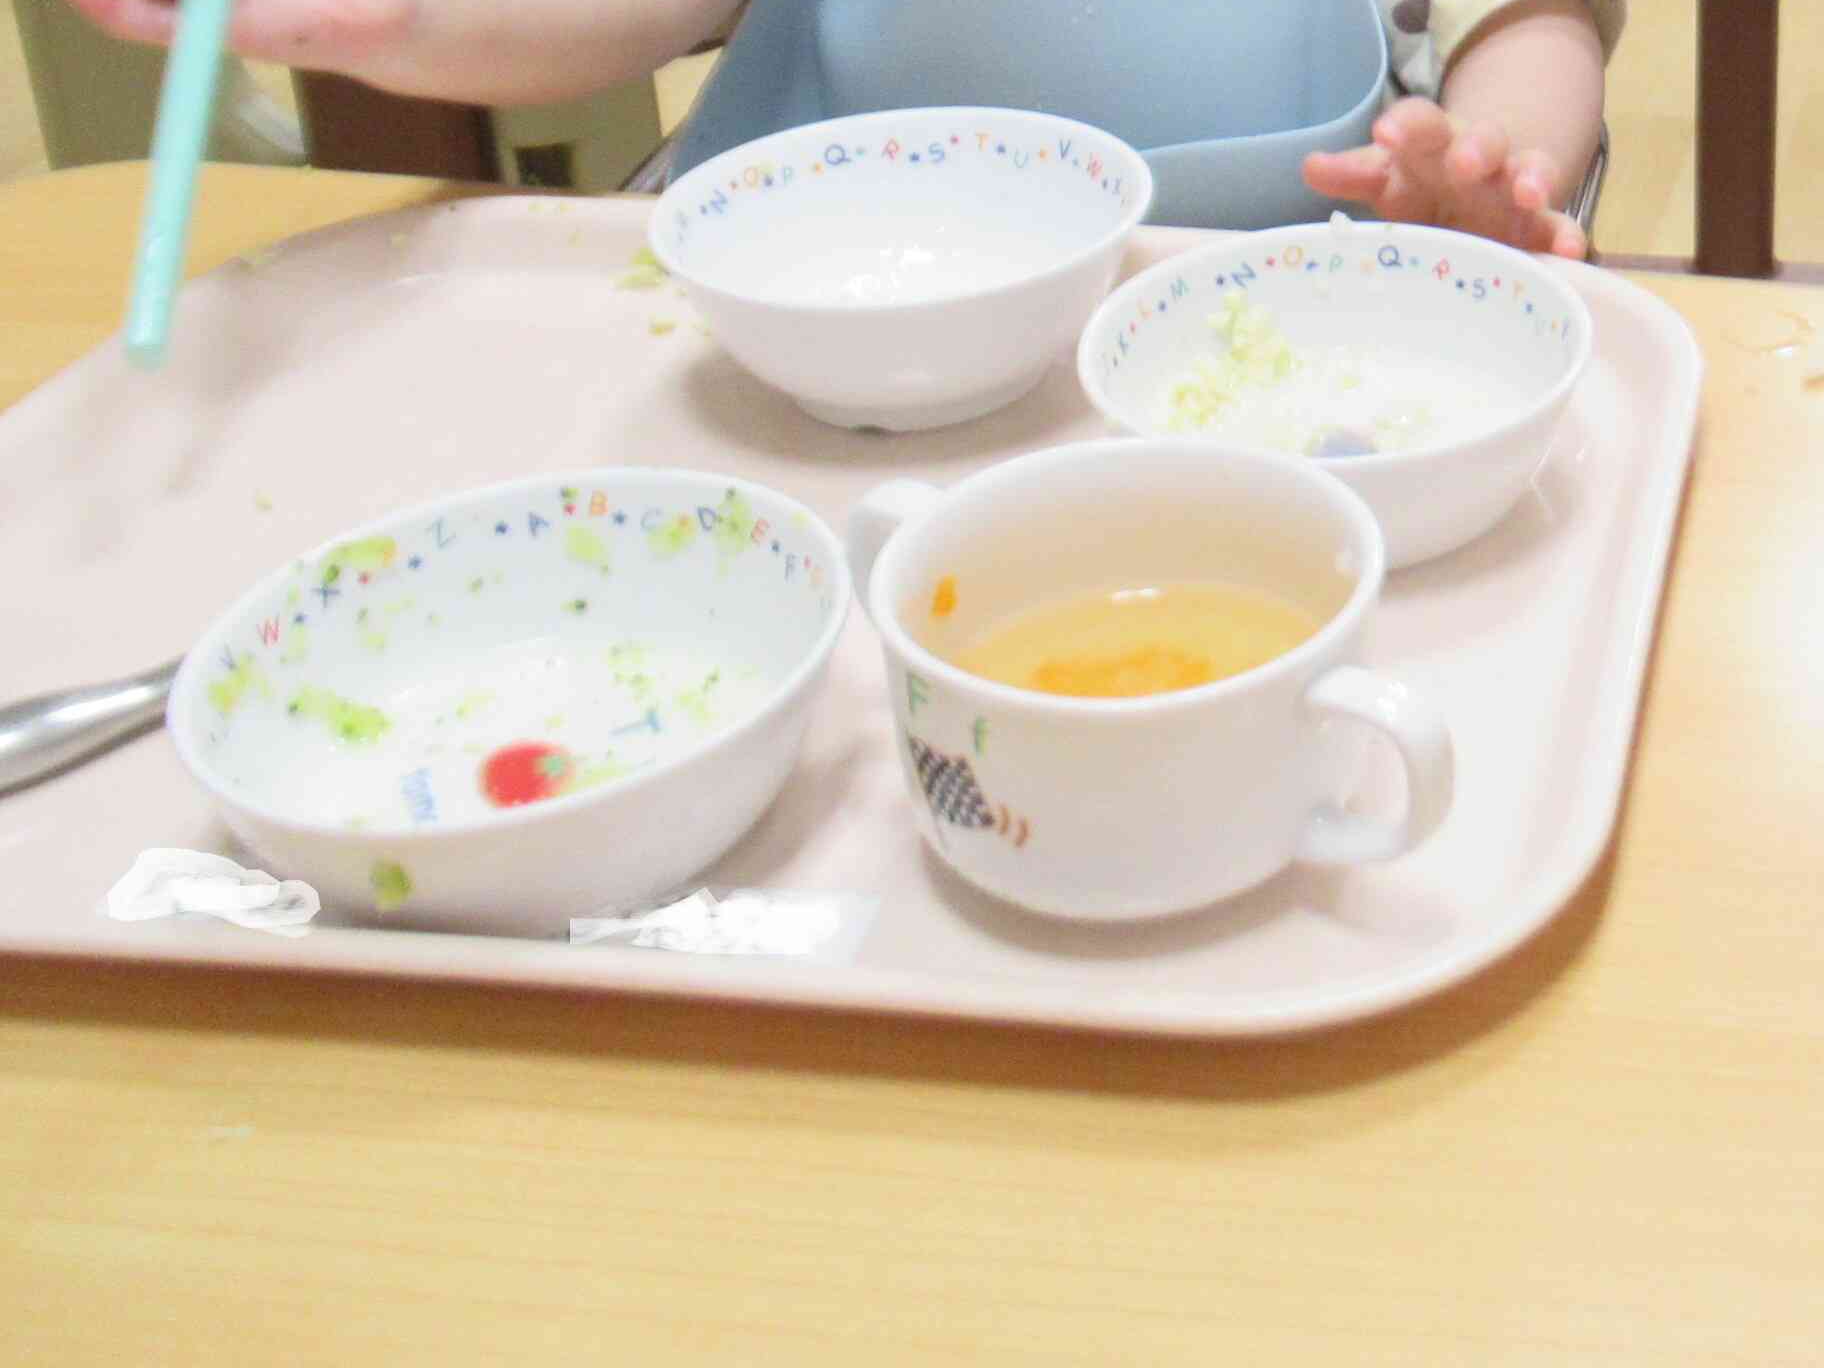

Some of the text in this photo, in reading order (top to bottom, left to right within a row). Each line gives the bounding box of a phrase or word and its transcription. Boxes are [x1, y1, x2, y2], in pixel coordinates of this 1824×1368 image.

[824, 143, 852, 166] Q
[880, 137, 900, 161] R
[927, 140, 946, 164] S
[974, 132, 992, 152] T
[1014, 147, 1030, 169] U
[1058, 139, 1073, 160] V
[1282, 245, 1305, 266] O
[1377, 244, 1403, 269] Q
[1472, 277, 1487, 301] S
[256, 612, 281, 647] W
[528, 511, 551, 538] A
[589, 489, 608, 517] B
[698, 505, 718, 531] D
